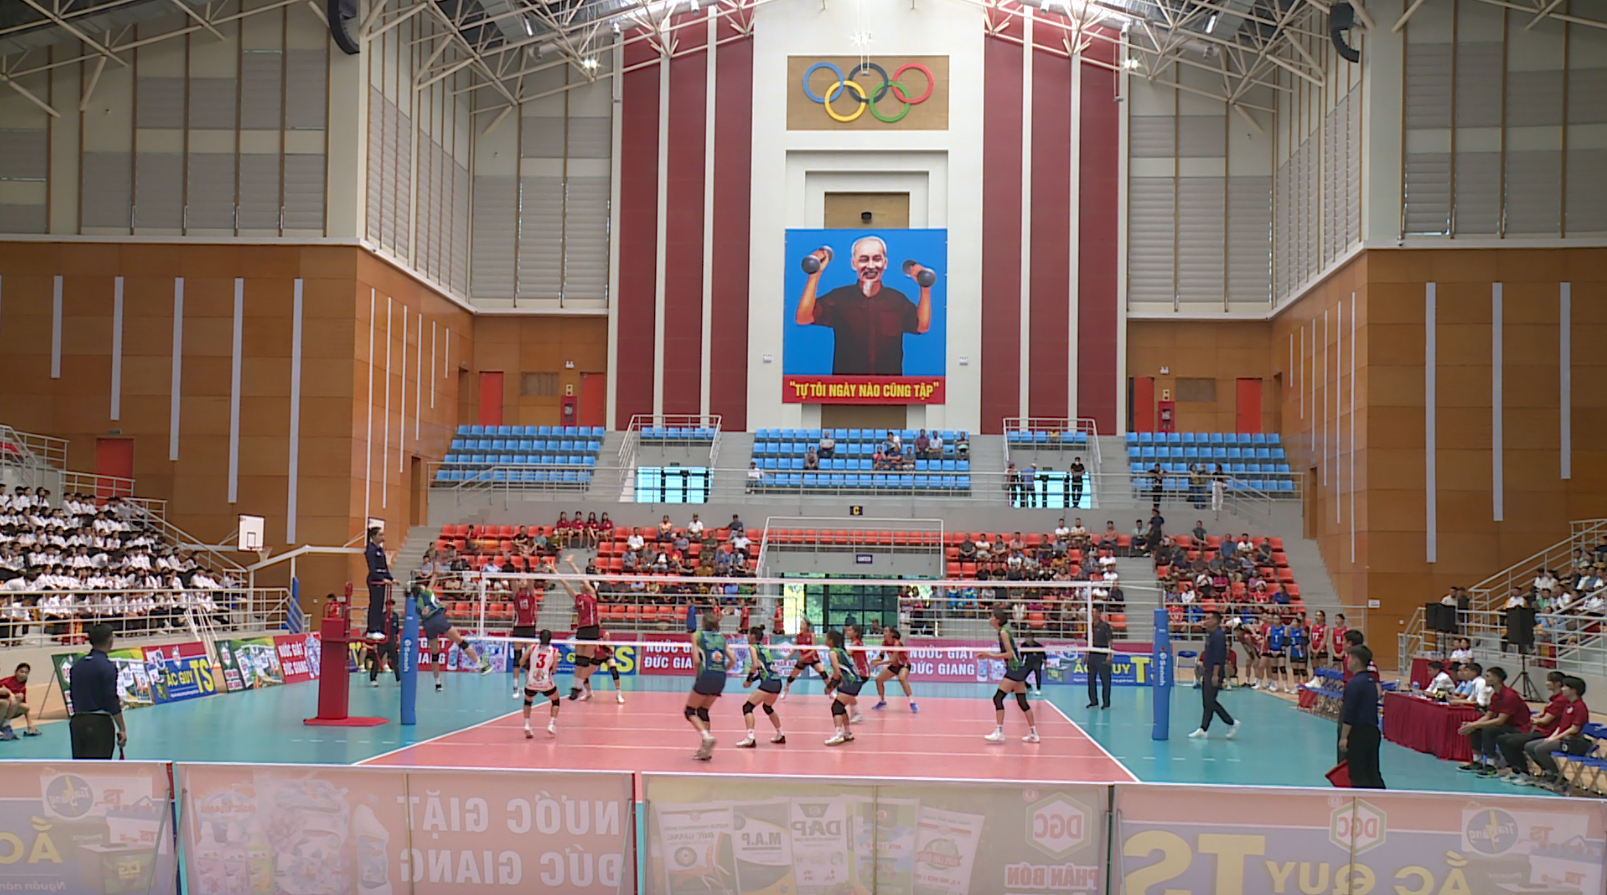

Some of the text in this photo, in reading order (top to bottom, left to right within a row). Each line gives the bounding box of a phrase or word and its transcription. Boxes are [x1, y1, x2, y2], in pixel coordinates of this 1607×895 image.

[810, 381, 826, 397] TÔI
[829, 382, 856, 398] NGÀY
[859, 382, 881, 398] NÀO
[883, 382, 912, 398] CŨNG
[853, 506, 860, 515] C
[536, 653, 547, 669] 3
[644, 654, 669, 669] ĐỨC
[672, 657, 693, 669] GIA
[189, 658, 215, 693] TS
[938, 663, 975, 675] GIANG
